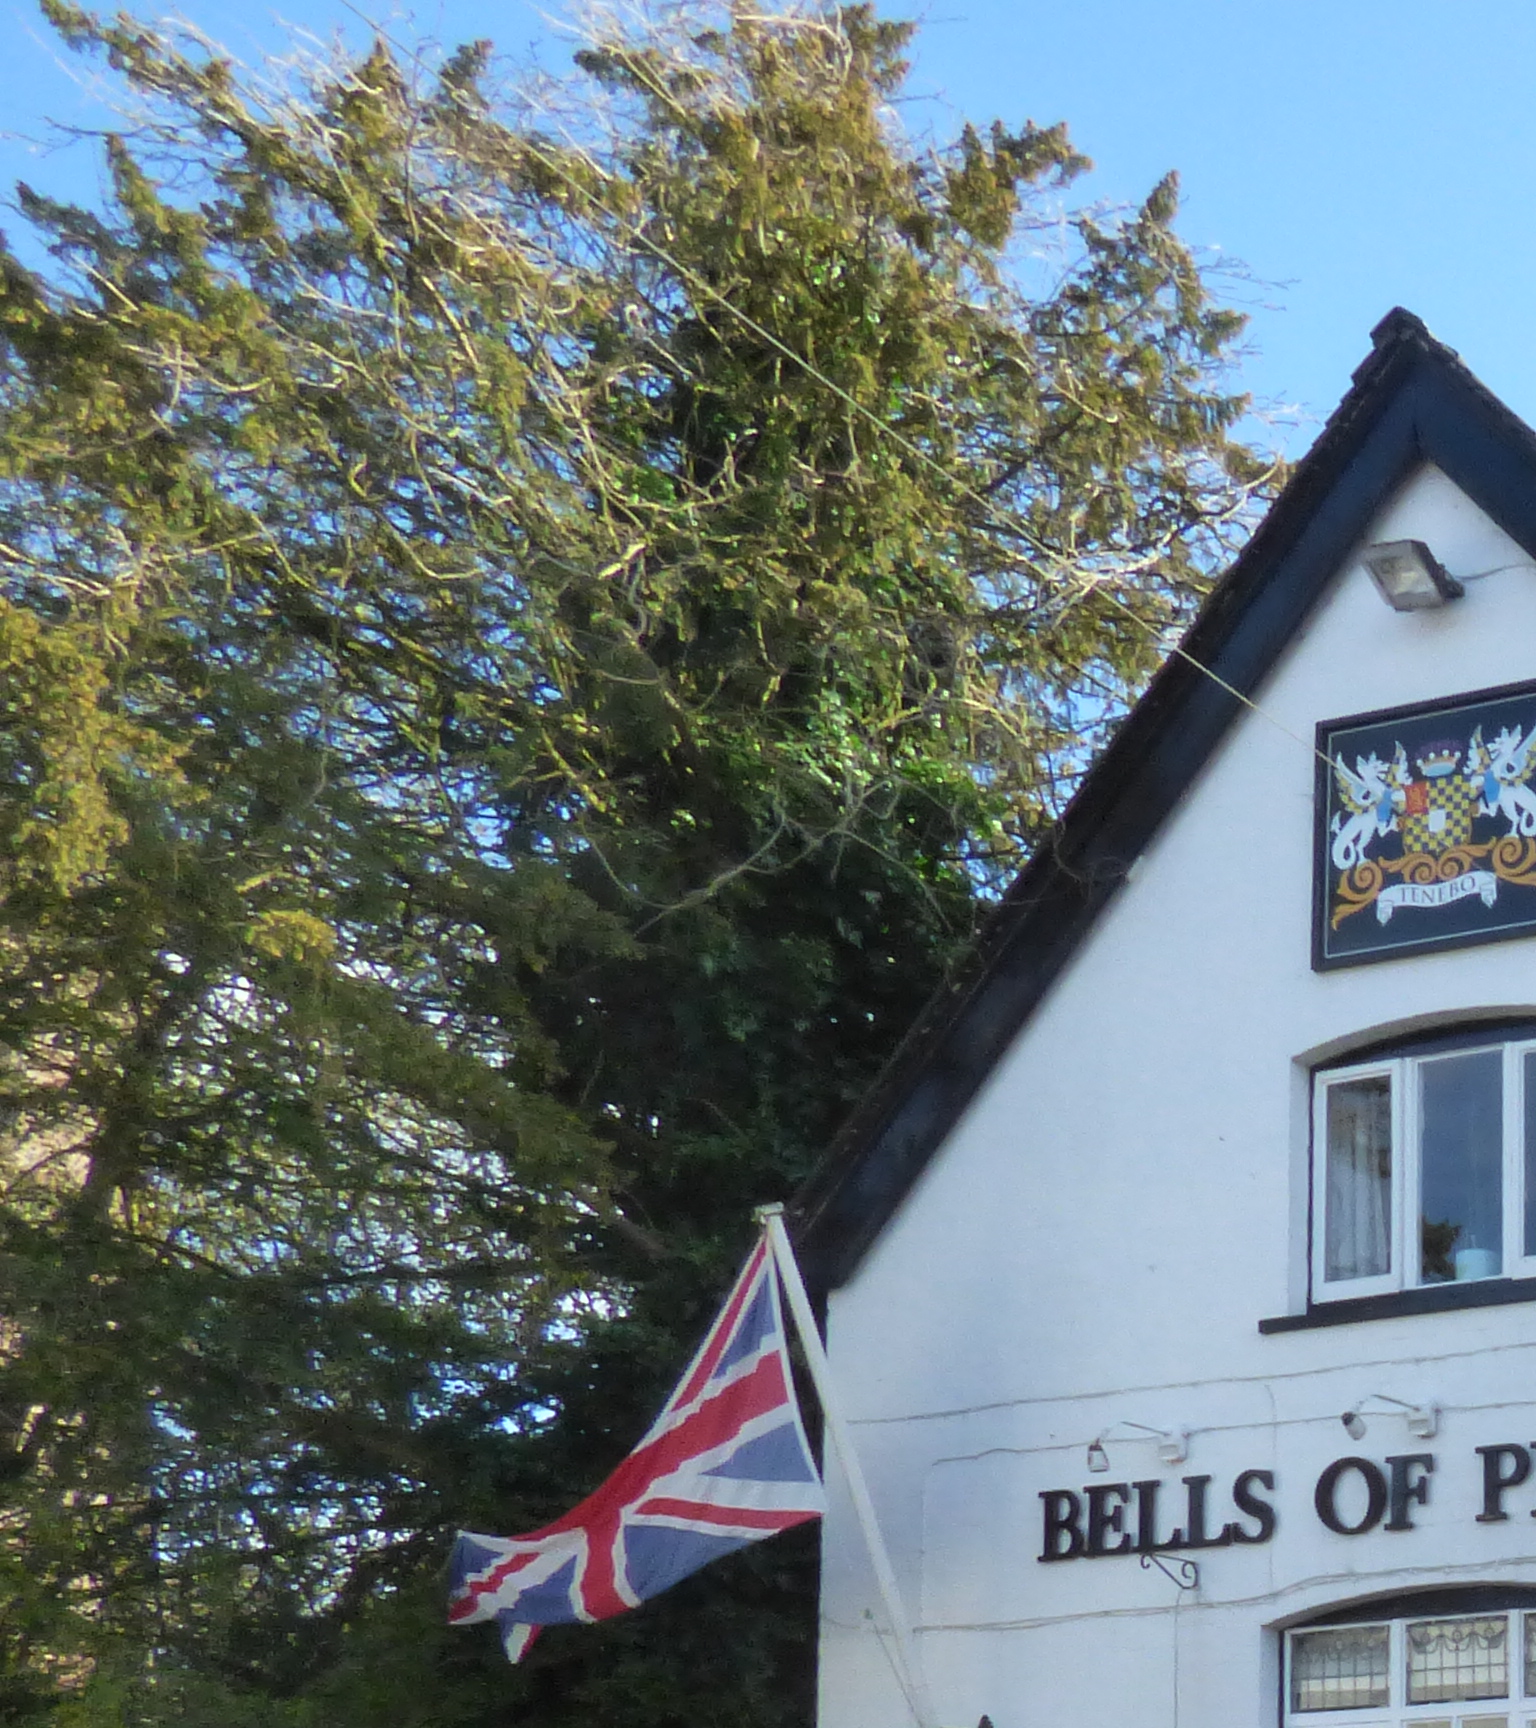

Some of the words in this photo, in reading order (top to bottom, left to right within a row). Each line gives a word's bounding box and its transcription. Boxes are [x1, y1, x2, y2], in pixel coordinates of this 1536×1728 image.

[1400, 875, 1476, 904] TENEBO
[1036, 1468, 1276, 1563] BELLS
[1314, 1452, 1434, 1536] OF
